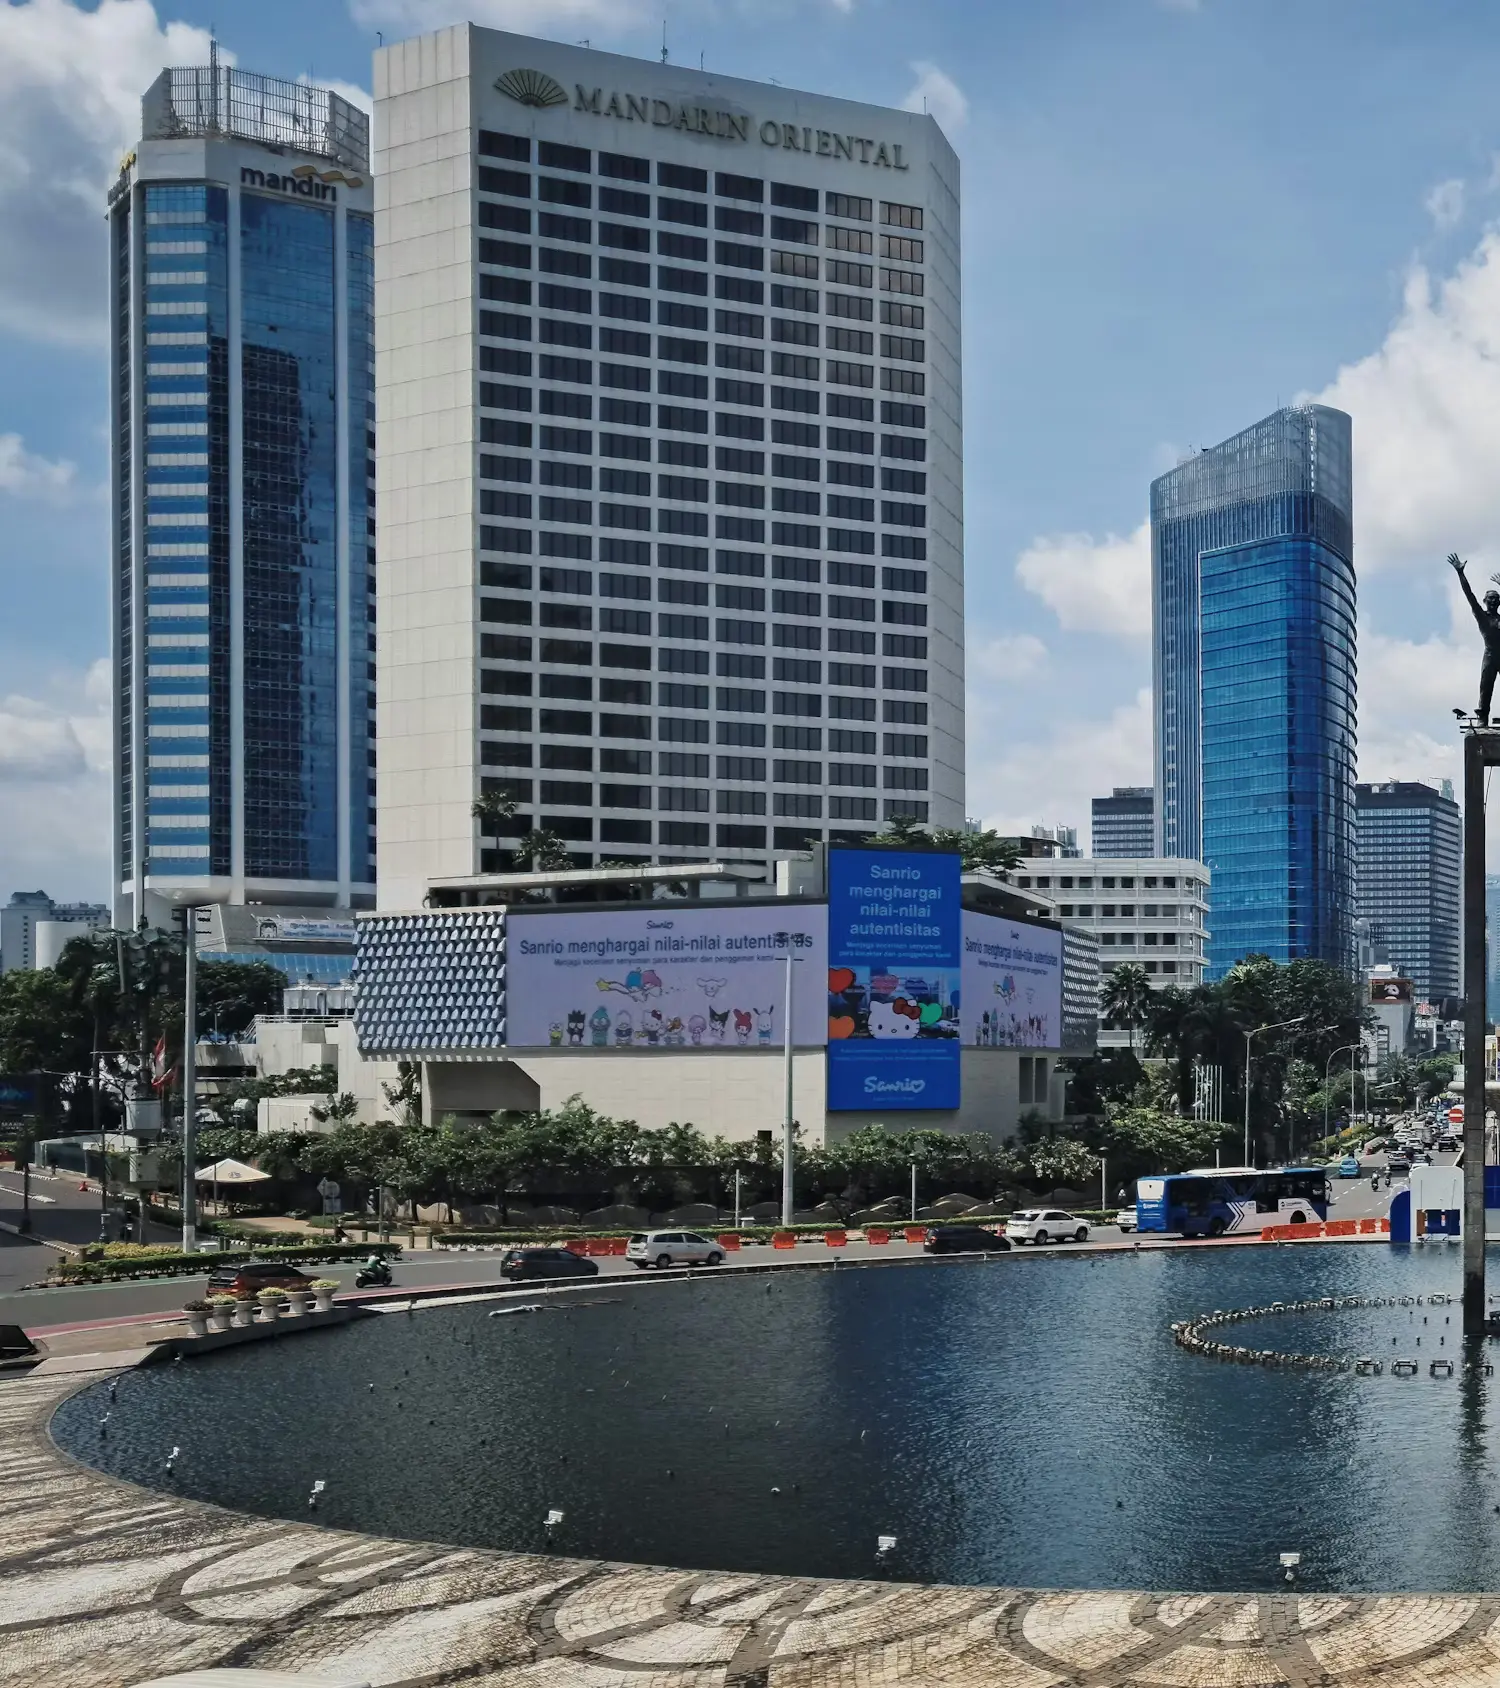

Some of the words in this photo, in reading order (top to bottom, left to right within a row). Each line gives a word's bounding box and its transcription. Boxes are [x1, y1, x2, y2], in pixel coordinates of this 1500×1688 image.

[574, 84, 748, 142] MANDARIN
[759, 119, 909, 170] ORIENTAL
[240, 166, 337, 202] mandiri
[870, 865, 921, 880] Sanrio
[849, 885, 942, 902] menghargai
[860, 903, 931, 918] nilai-nilai
[850, 923, 941, 937] autentisitas
[520, 939, 564, 955] Sanrio
[568, 937, 650, 957] menghargai
[655, 934, 721, 951] nilai-nilai
